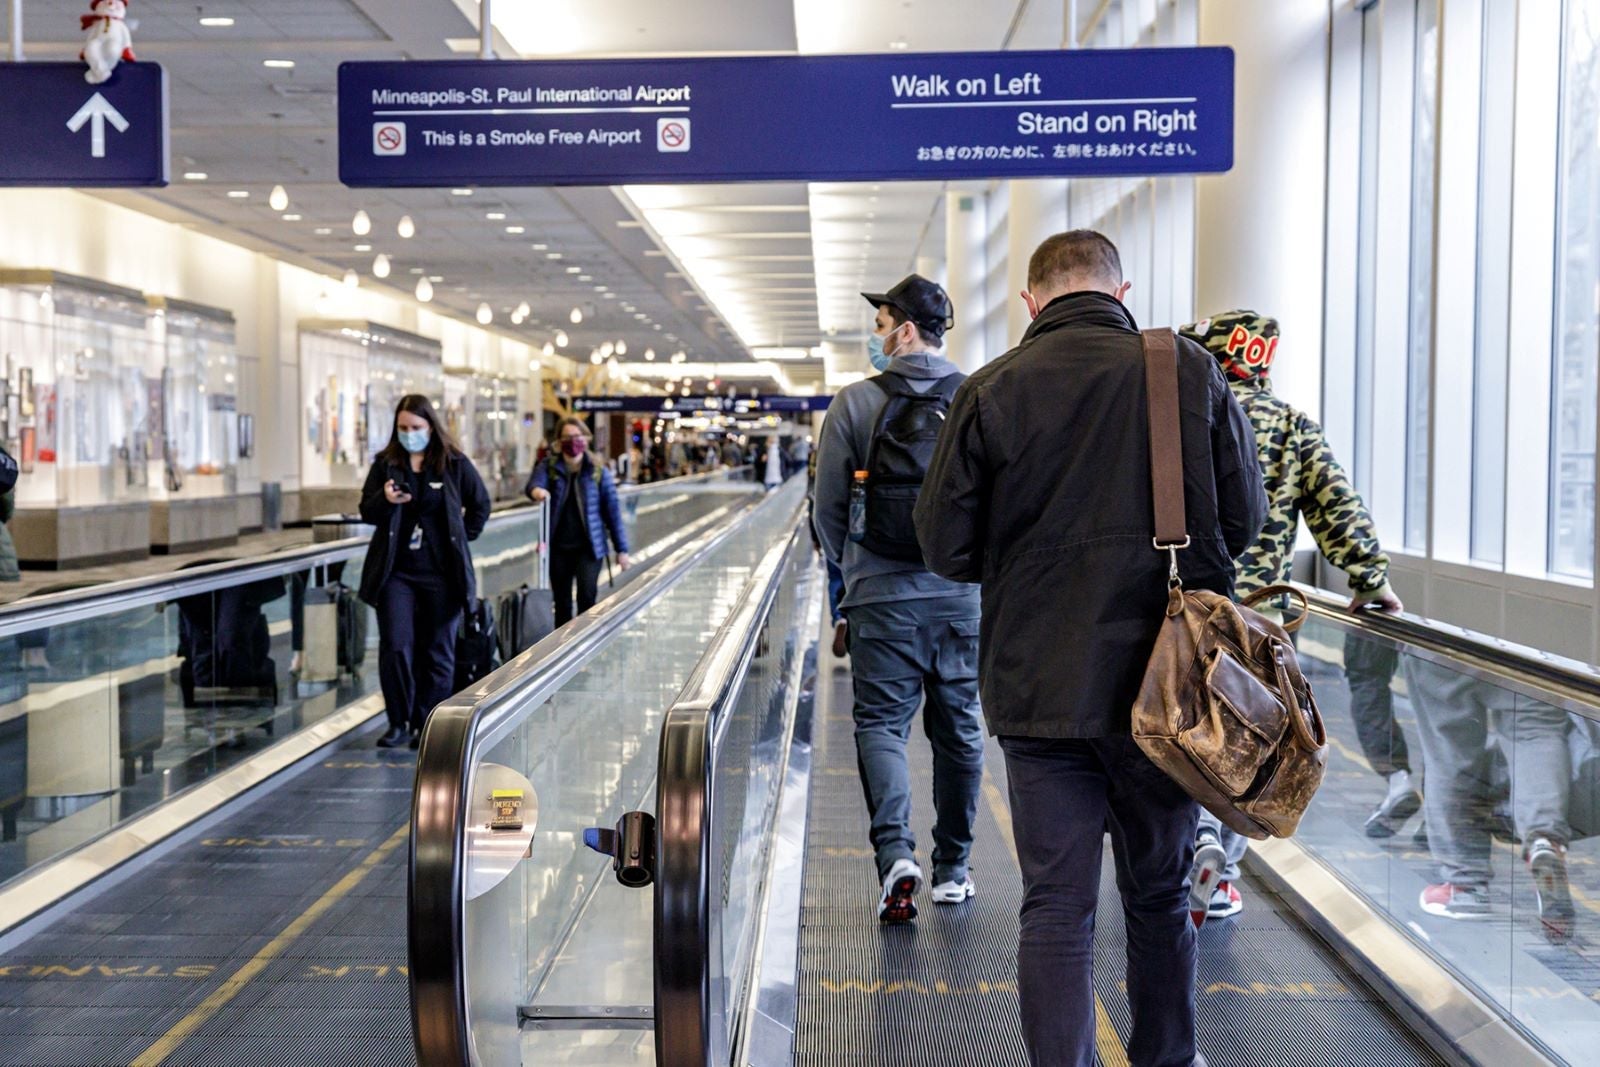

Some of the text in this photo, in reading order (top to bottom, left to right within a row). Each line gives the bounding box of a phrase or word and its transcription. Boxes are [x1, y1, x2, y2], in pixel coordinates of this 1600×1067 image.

[372, 85, 691, 107] Minneapolis-St. Paul International Airport
[891, 72, 1041, 97] Walk on Left
[1017, 109, 1197, 137] Stand on Right
[422, 128, 641, 147] This is a Smoke Free Airport
